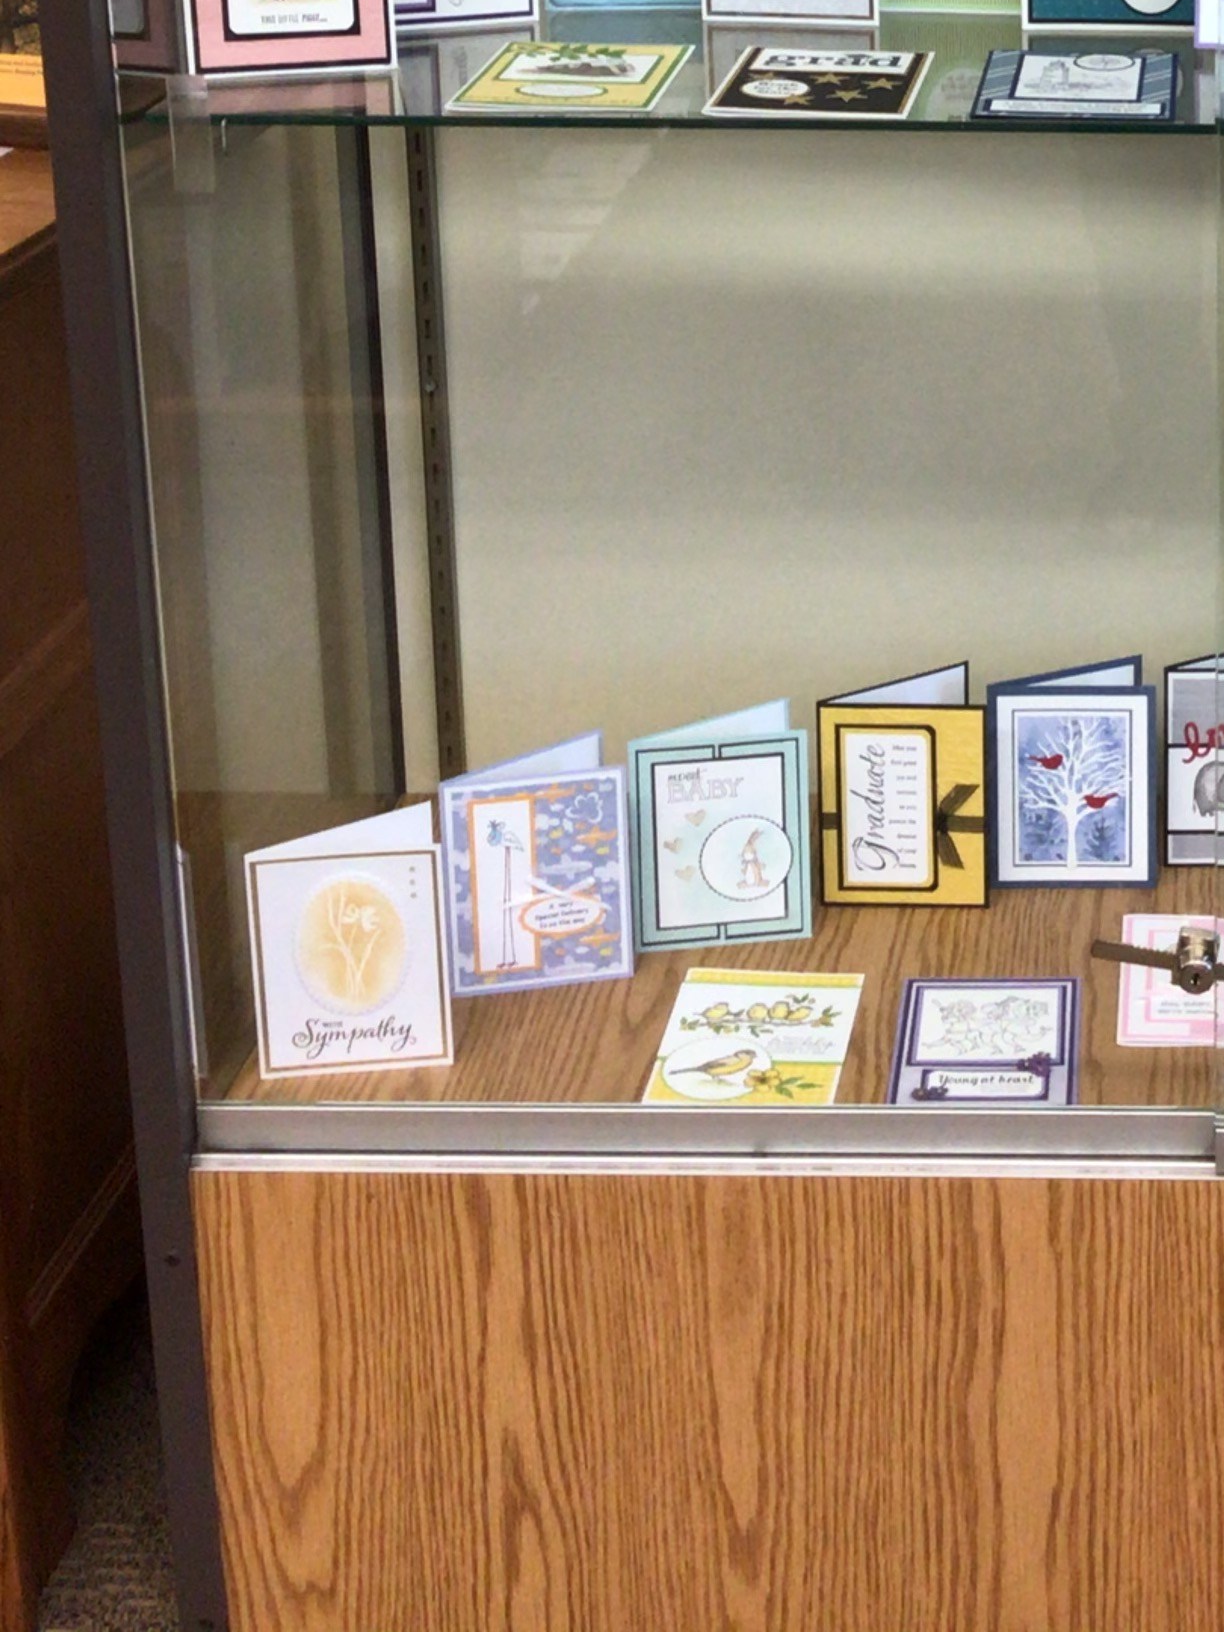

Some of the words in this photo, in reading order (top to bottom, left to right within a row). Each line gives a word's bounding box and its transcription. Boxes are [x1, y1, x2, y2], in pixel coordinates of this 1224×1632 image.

[763, 53, 904, 68] grad
[667, 777, 745, 804] BABY
[850, 743, 900, 871] Graduate
[291, 1014, 417, 1060] Sympathy
